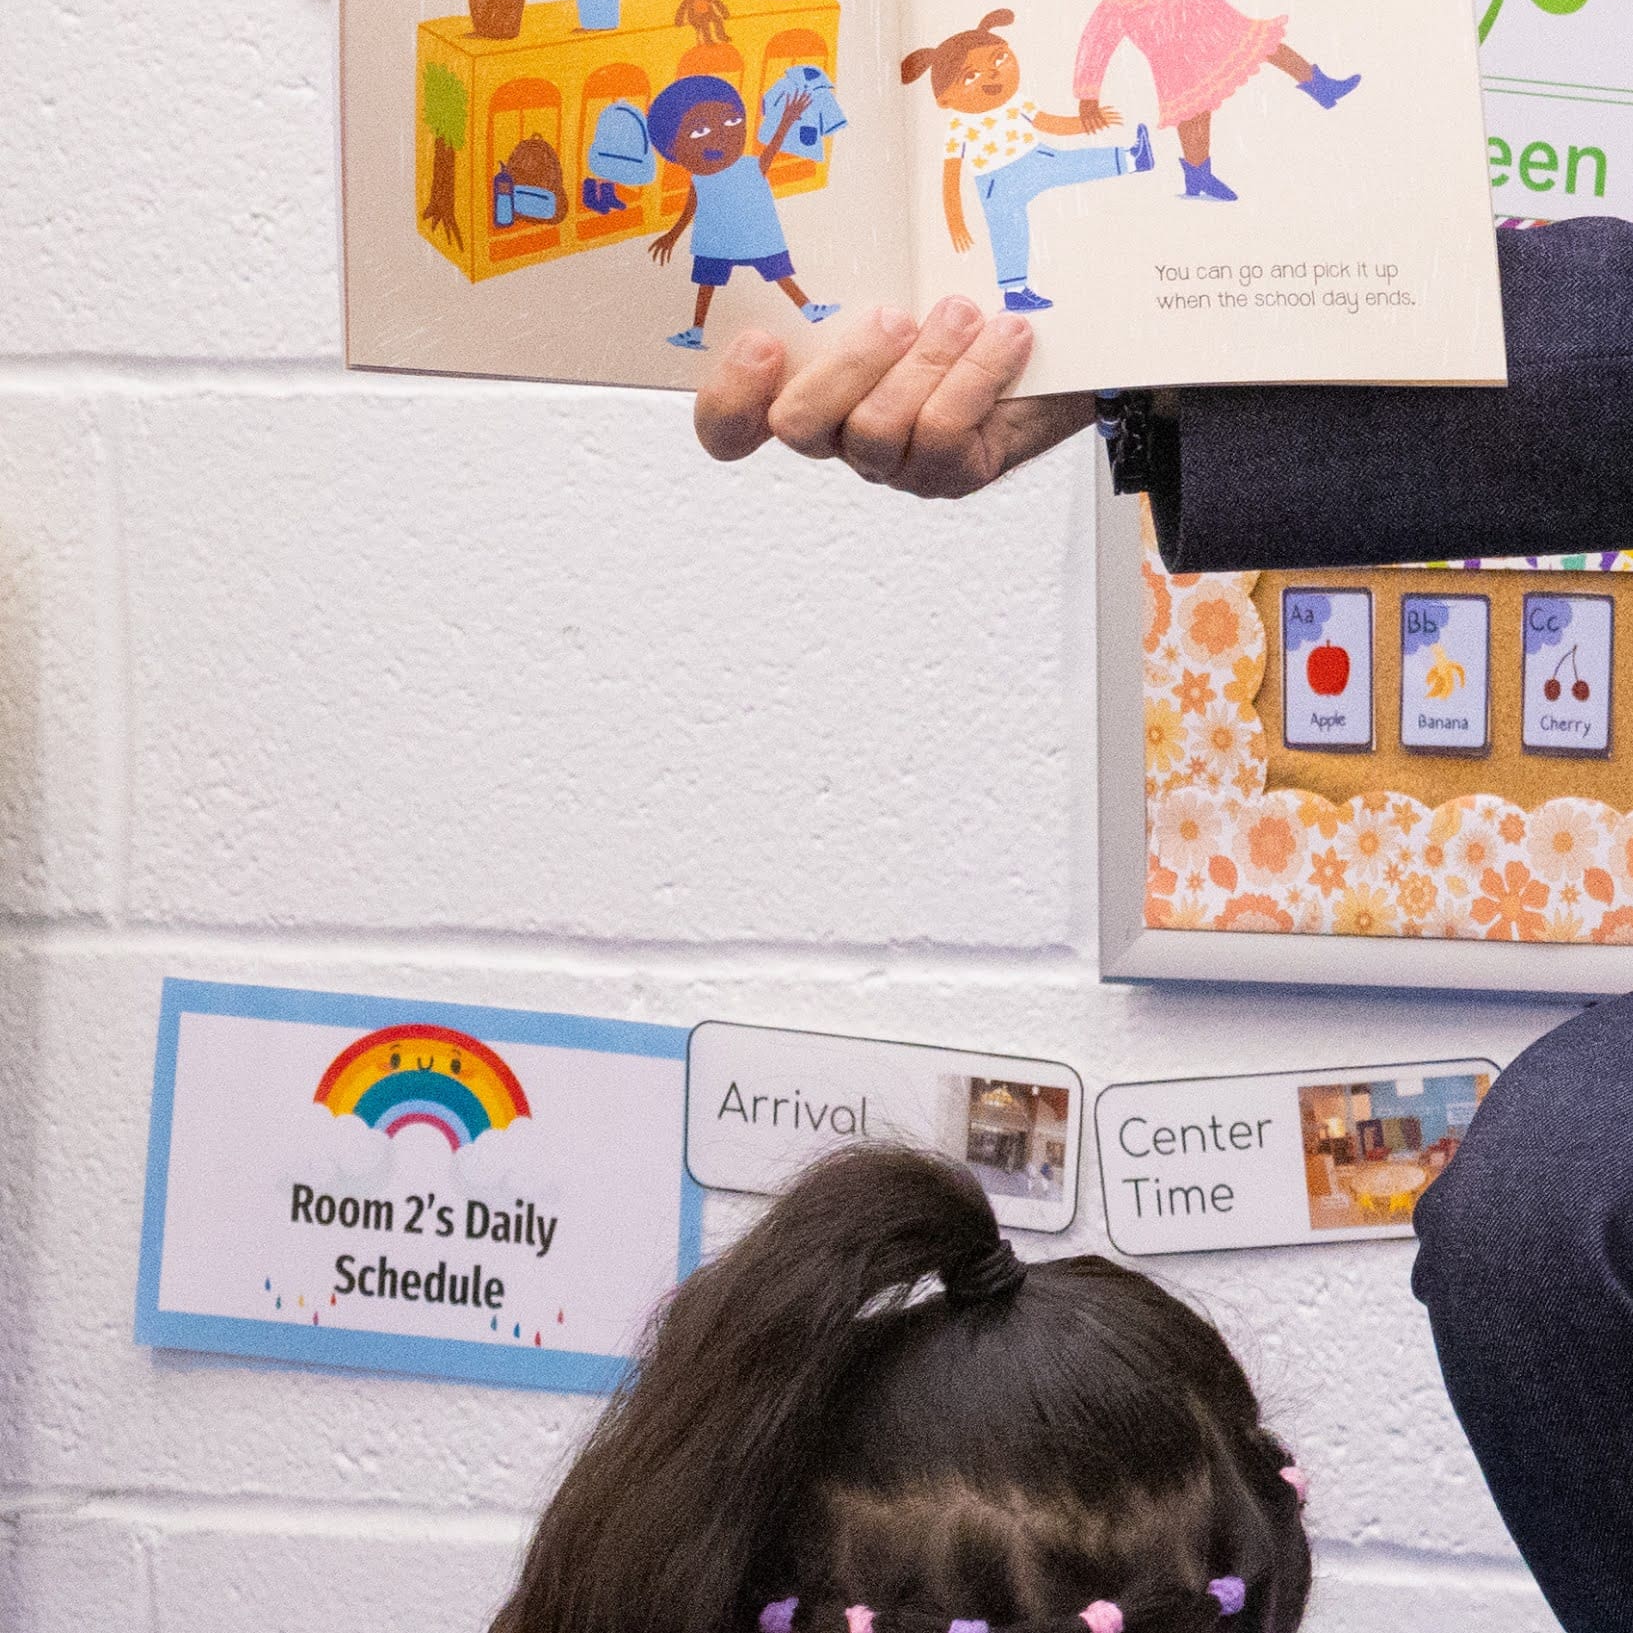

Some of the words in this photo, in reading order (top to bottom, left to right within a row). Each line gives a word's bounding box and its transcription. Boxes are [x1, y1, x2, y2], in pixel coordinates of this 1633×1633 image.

[1155, 264, 1191, 282] You
[1195, 265, 1233, 280] can
[1238, 264, 1264, 287] go
[1270, 262, 1308, 278] and
[1313, 260, 1353, 284] pick
[1357, 262, 1370, 277] it
[1375, 264, 1399, 285] up
[1157, 291, 1211, 309] when
[1217, 291, 1249, 308] the
[1255, 289, 1315, 307] school
[1322, 289, 1359, 314] day
[1365, 289, 1416, 306] ends.
[1310, 712, 1346, 729] Apple
[1418, 714, 1469, 730] Banana
[1540, 715, 1591, 737] Cherry
[717, 1081, 869, 1140] Arrival
[1118, 1116, 1273, 1159] Center
[1124, 1176, 1235, 1220] Time
[291, 1183, 393, 1232] Room
[404, 1194, 454, 1237] 2's
[465, 1199, 557, 1257] Daily
[334, 1255, 505, 1310] Schedule
